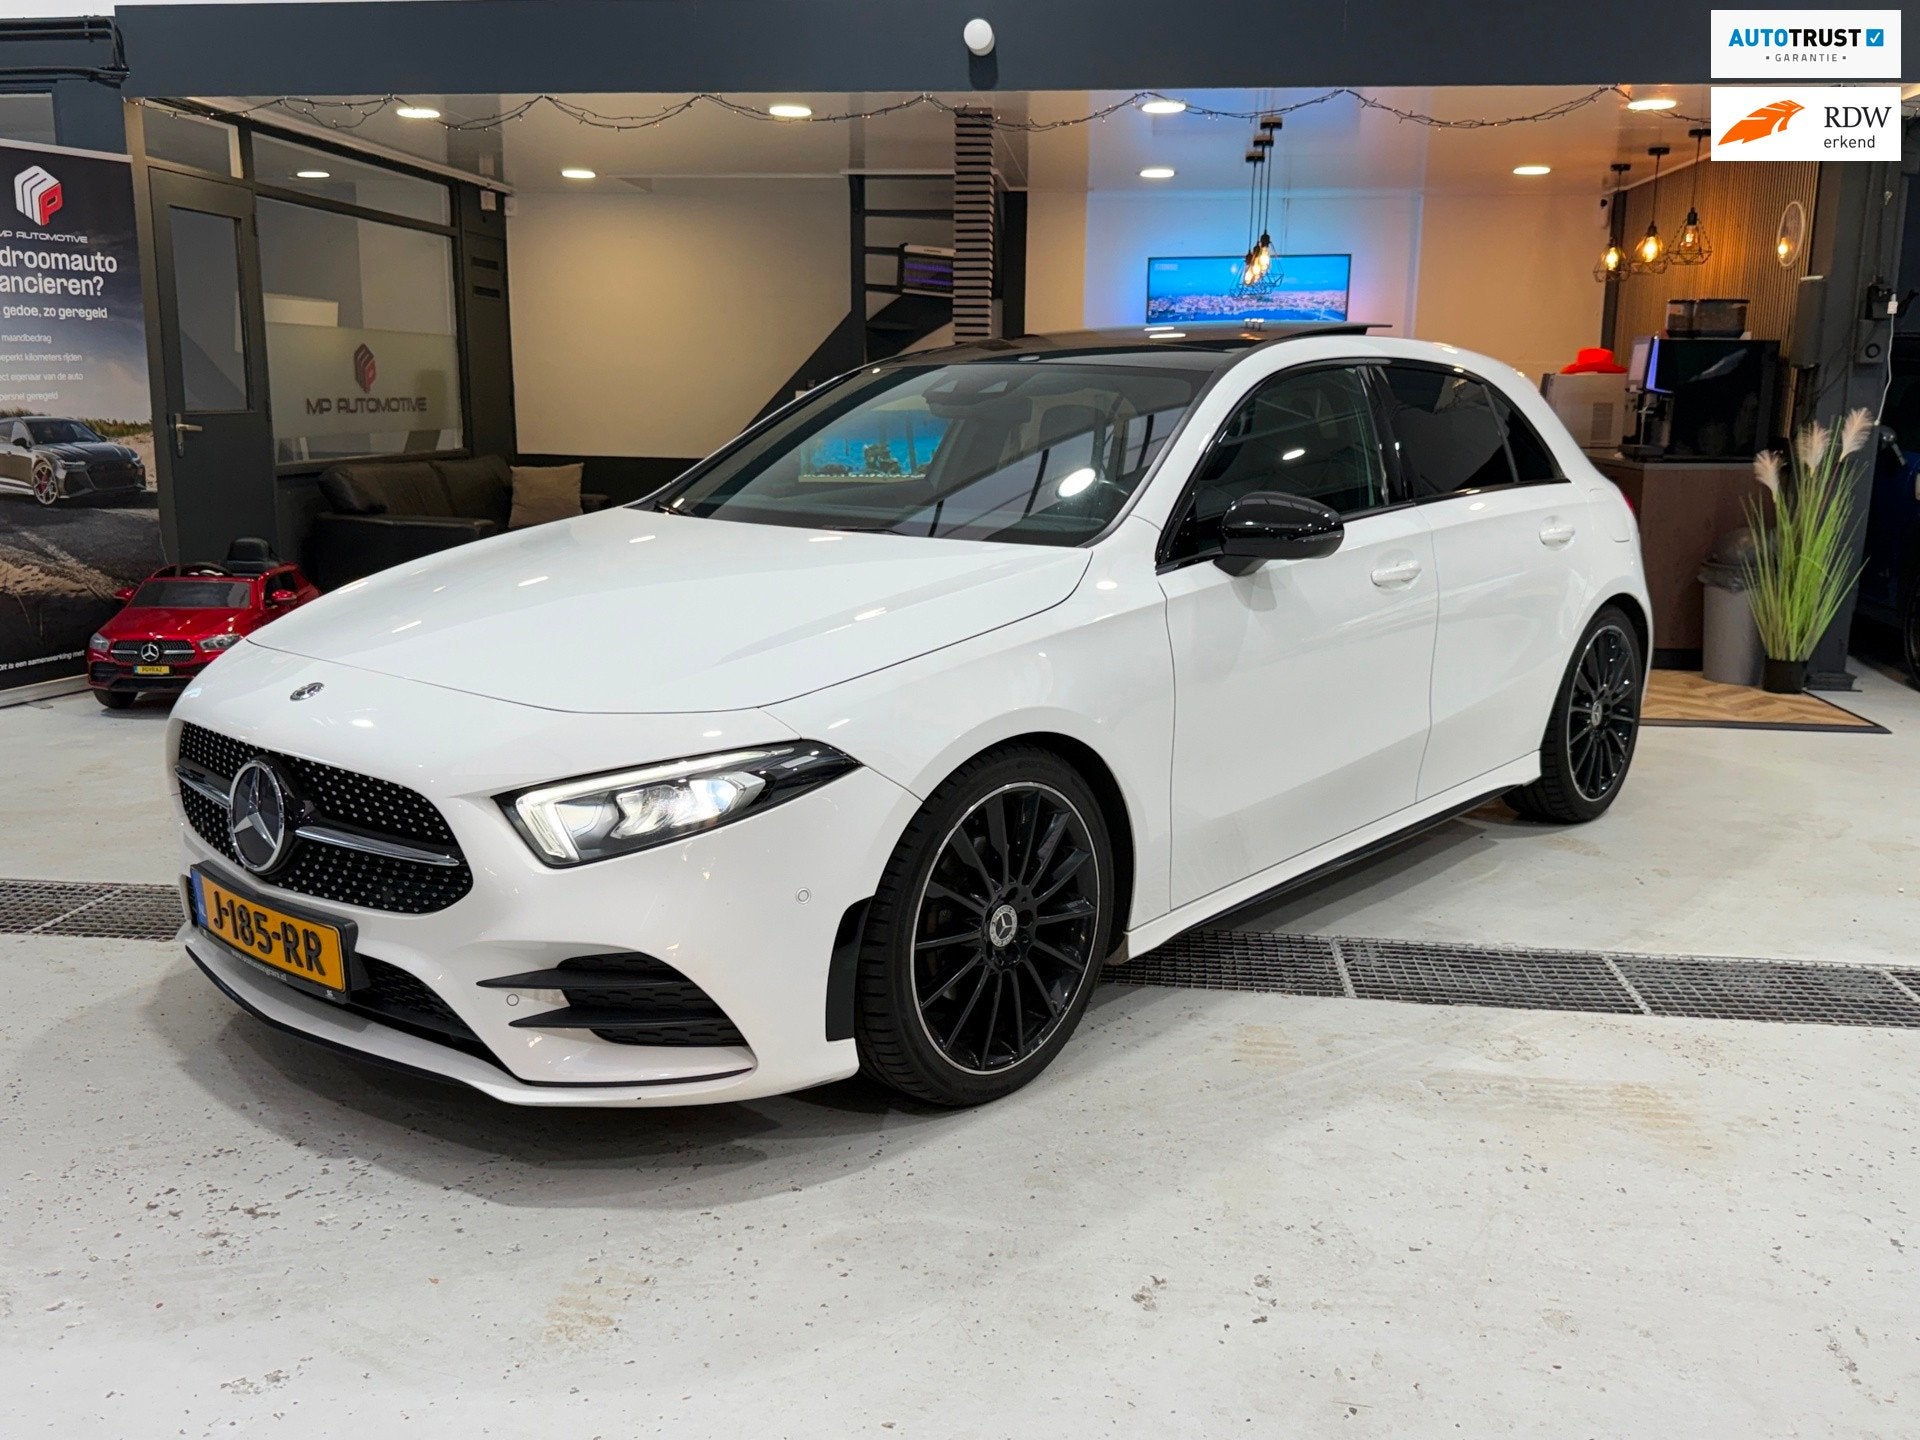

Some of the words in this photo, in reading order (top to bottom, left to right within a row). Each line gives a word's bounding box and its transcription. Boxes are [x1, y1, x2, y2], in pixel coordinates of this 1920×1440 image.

[16, 231, 88, 244] AUTOMOTIVE
[0, 246, 117, 273] droomauto
[0, 272, 104, 296] ancieren?
[3, 305, 42, 318] gedoe,
[43, 307, 57, 317] zo
[58, 307, 108, 320] geregeld
[1, 334, 52, 344] maandbedrag
[25, 353, 62, 361] kilometers
[67, 373, 84, 381] auto
[306, 398, 332, 415] MP
[337, 397, 428, 414] AUTOMOTIVE
[213, 890, 326, 977] J-185-RR
